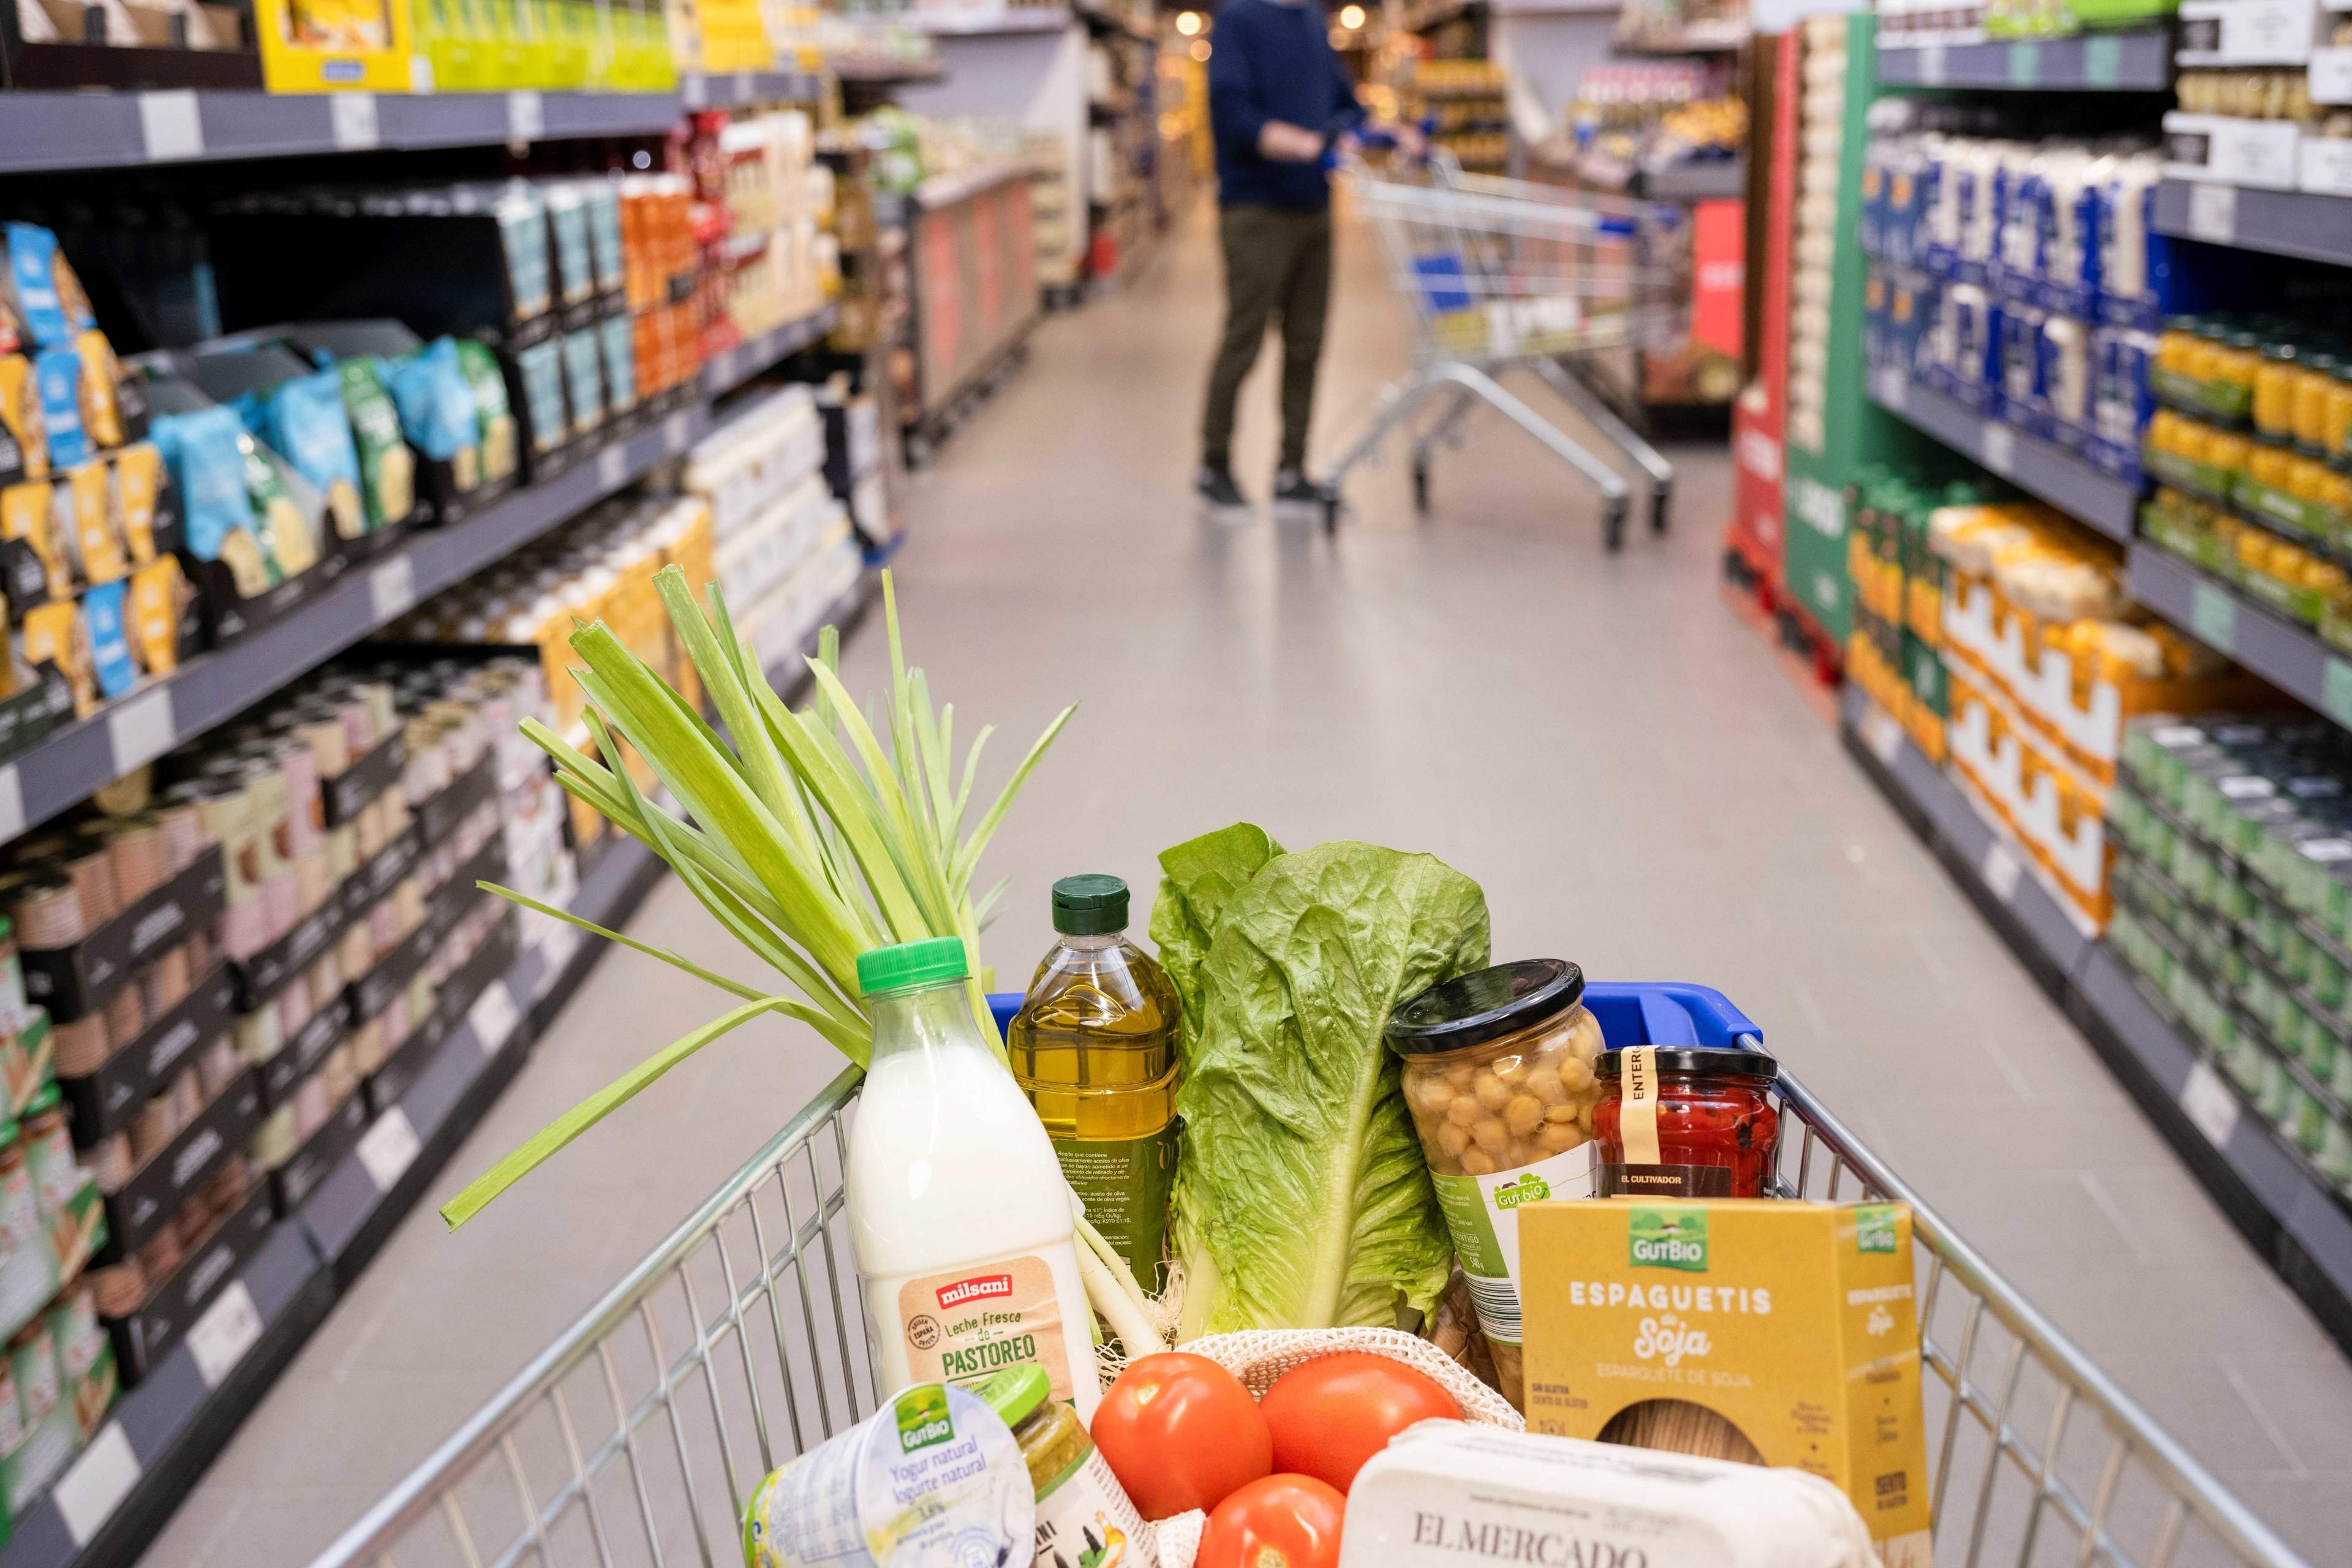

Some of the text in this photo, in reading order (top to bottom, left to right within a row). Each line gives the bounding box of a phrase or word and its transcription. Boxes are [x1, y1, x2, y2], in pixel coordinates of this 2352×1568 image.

[1630, 1175, 1681, 1184] CULTIVADOR
[941, 1276, 1009, 1305] milsani
[1570, 1281, 1771, 1315] ESPAGUETIS
[914, 1325, 934, 1340] ESPAÑA
[945, 1312, 1021, 1338] Leche Fresca
[978, 1328, 990, 1341] de
[942, 1334, 1036, 1376] PASTOREO
[1634, 1317, 1713, 1367] Soja
[932, 1434, 978, 1466] natural
[941, 1453, 987, 1486] natural
